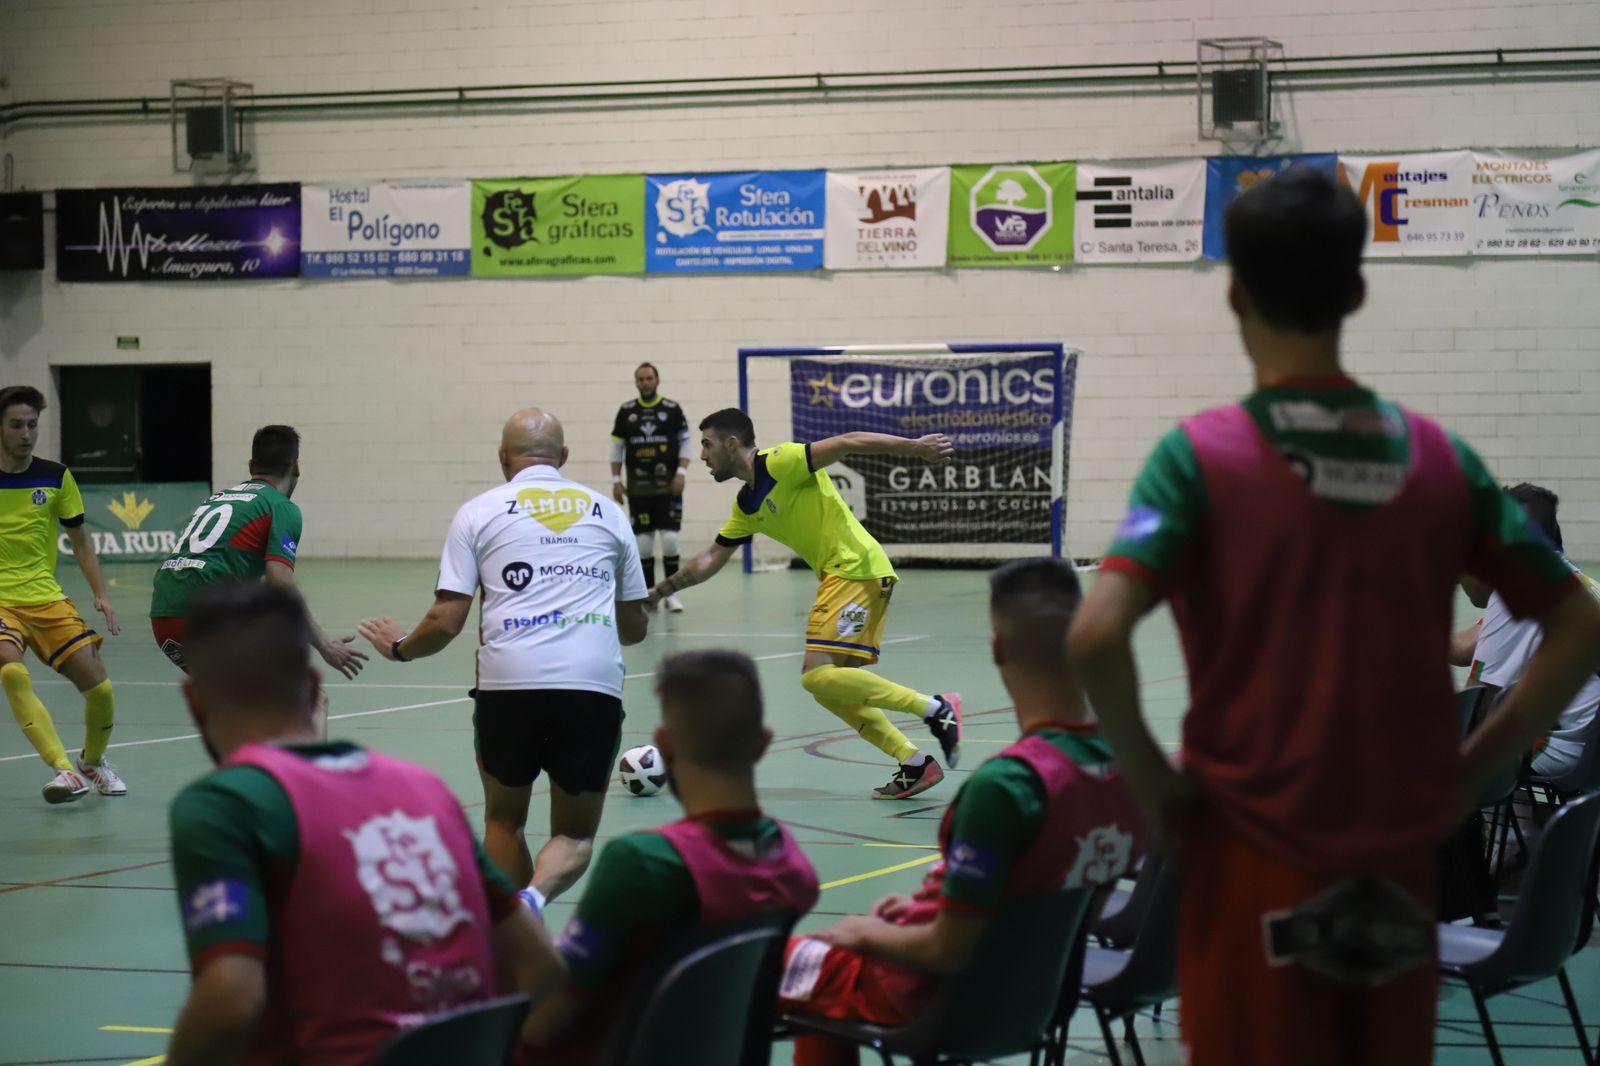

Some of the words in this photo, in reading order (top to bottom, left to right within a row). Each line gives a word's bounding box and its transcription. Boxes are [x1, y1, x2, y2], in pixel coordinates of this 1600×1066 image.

[1475, 161, 1548, 171] MONTAJES
[329, 189, 370, 204] Hostal
[739, 184, 790, 206] Sfera
[1116, 185, 1175, 200] antalia
[562, 193, 618, 217] Sfera
[716, 207, 815, 227] Rotulación
[329, 207, 343, 221] El
[348, 210, 440, 246] Polígono
[547, 220, 634, 245] gráficas
[857, 227, 917, 239] TIERRA
[1098, 241, 1133, 254] Santa
[1137, 240, 1181, 254] Teresa,
[241, 258, 260, 272] 10
[840, 364, 1054, 409] euronics
[901, 410, 1053, 427] electrodoméstico
[505, 498, 603, 519] ZAMORA
[881, 499, 958, 511] ESTUDIOS
[967, 498, 986, 510] DE
[998, 497, 1050, 510] COCIN
[172, 503, 233, 554] 10
[122, 530, 177, 554] RUR
[540, 537, 579, 545] ENAMORA
[540, 565, 610, 582] MORALEJO
